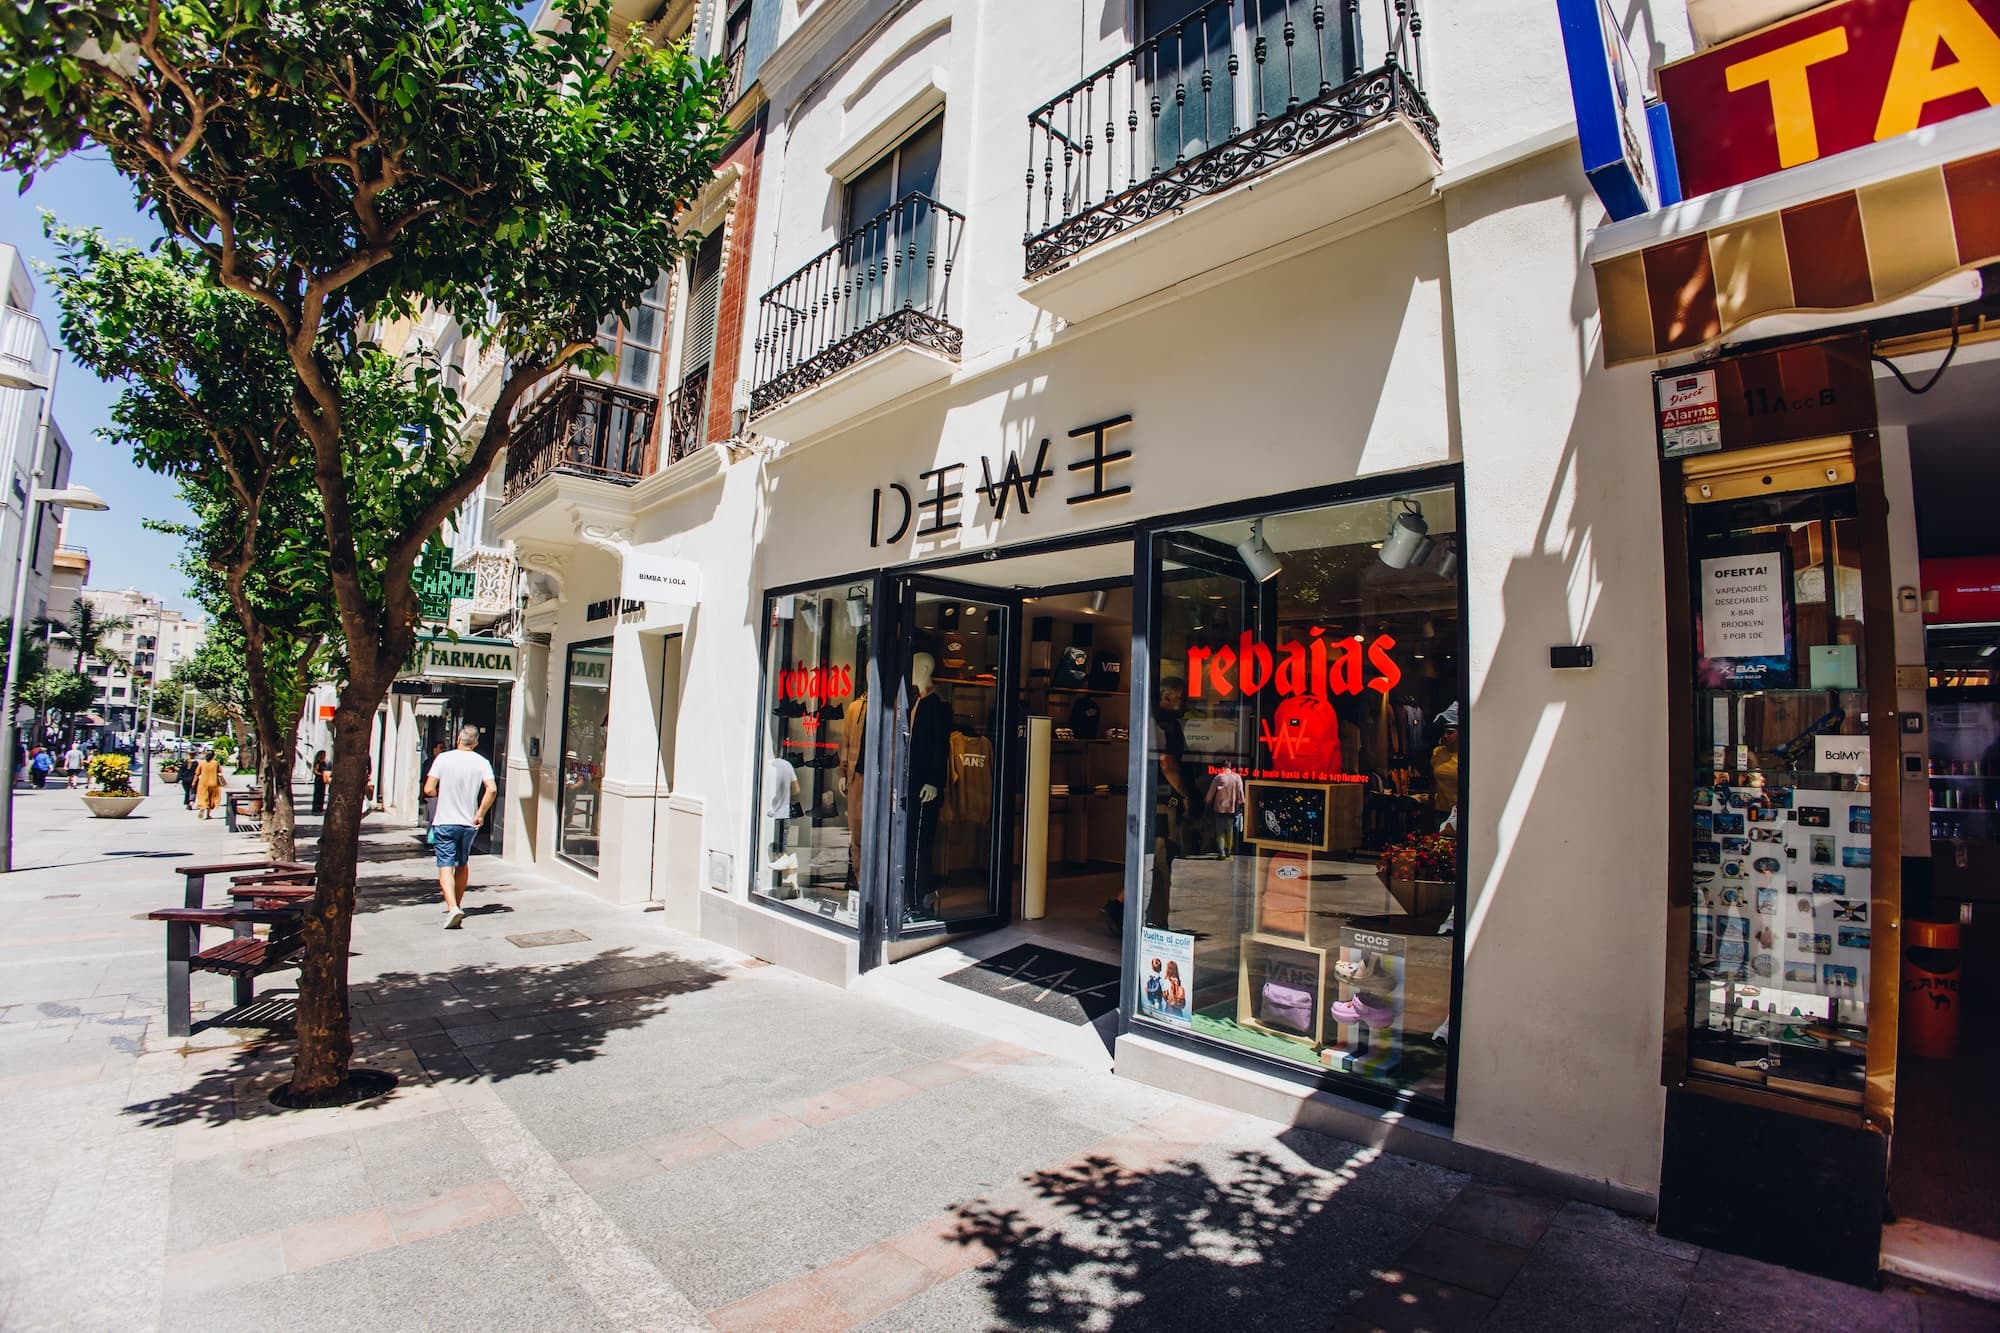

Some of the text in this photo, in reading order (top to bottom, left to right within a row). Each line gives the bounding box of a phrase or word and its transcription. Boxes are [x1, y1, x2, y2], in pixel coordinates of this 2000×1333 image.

[1725, 0, 2000, 169] TA
[1664, 406, 1716, 422] Alarma
[870, 414, 1133, 548] DEWE
[1714, 566, 1768, 579] OFERTA!
[639, 573, 662, 583] BIMBA
[668, 577, 687, 586] LOLA
[1715, 584, 1768, 595] VAPEADORES
[1714, 595, 1769, 606] DESECHABLES
[1729, 608, 1754, 617] X-BAR
[1720, 619, 1764, 629] BROOKLYN
[1729, 632, 1747, 640] POR
[430, 650, 512, 671] FARMACIA
[1101, 661, 1121, 673] VANS
[1187, 626, 1401, 701] rebajas
[1720, 664, 1768, 674] X-BAR
[777, 659, 853, 707] rebajas
[959, 753, 986, 768] VANS
[1825, 750, 1861, 761] BalMY
[1143, 930, 1164, 942] Vuelta
[1165, 935, 1173, 943] al
[1354, 932, 1389, 946] crocs
